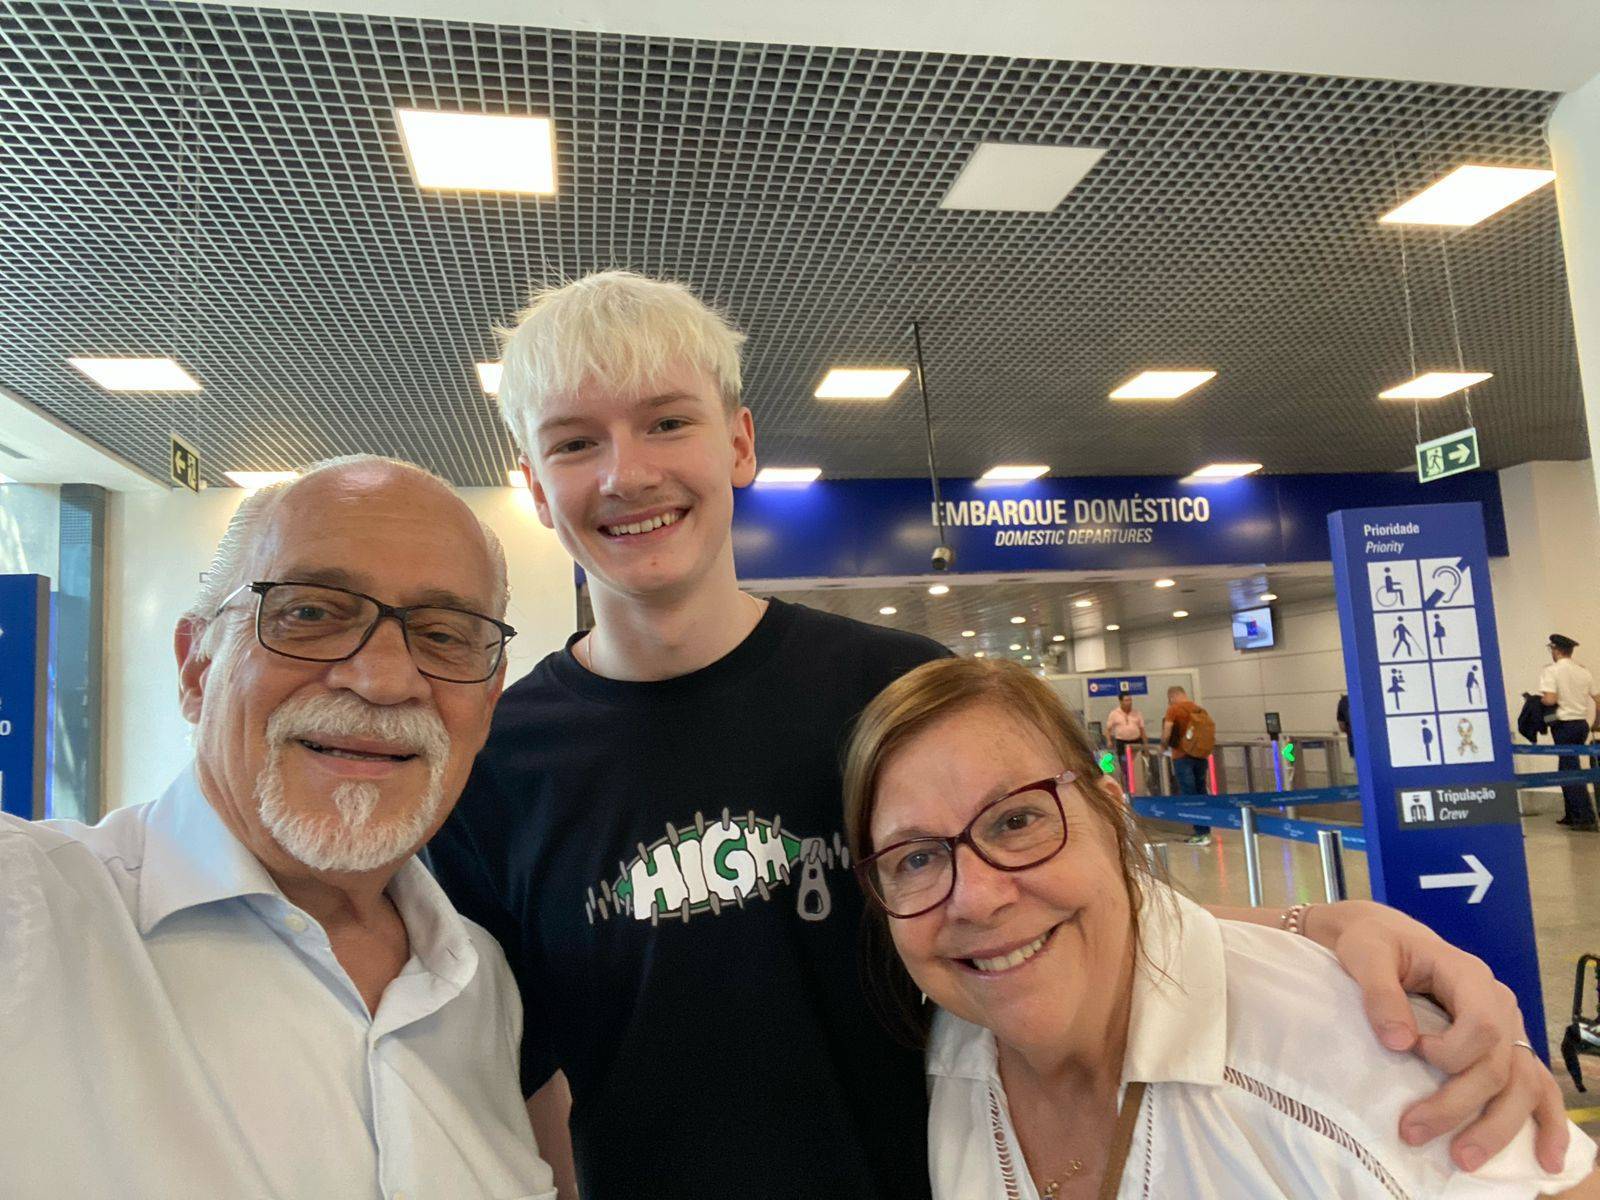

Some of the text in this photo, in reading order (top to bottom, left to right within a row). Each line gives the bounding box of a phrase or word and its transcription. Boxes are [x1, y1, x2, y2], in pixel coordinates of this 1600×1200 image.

[931, 493, 1210, 527] EMBARQUE DOMÉSTICO
[995, 528, 1153, 547] DOMESTIC DEPARTURES
[1363, 522, 1420, 537] Prioridade
[1365, 540, 1405, 555] Priority
[1437, 787, 1496, 804] Tripulação
[1439, 807, 1469, 821] Crew
[631, 819, 791, 921] HIGH
